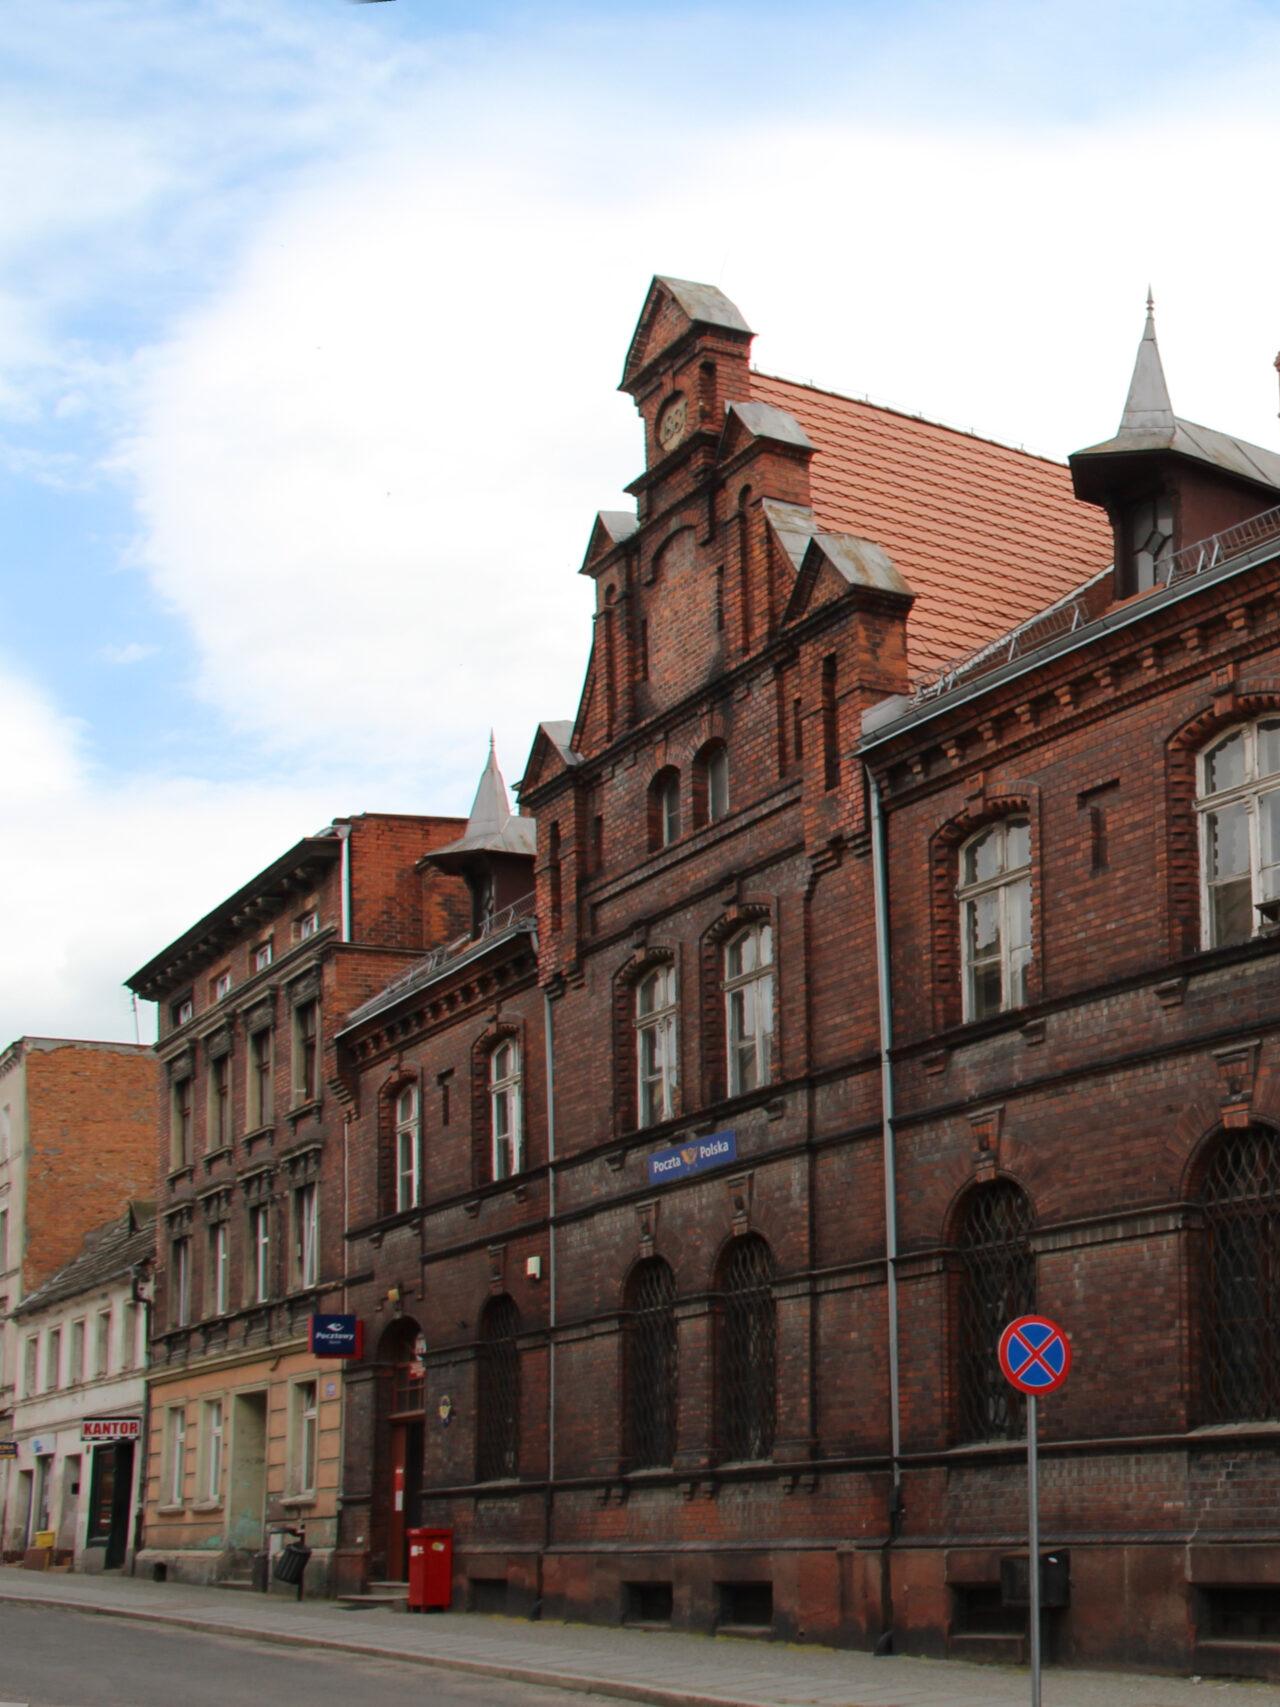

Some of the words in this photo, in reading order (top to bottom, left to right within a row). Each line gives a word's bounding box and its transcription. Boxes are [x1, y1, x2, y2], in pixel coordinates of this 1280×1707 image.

[653, 1156, 681, 1173] Poczta
[700, 1140, 729, 1158] Polska
[83, 1422, 138, 1435] KANTOR
